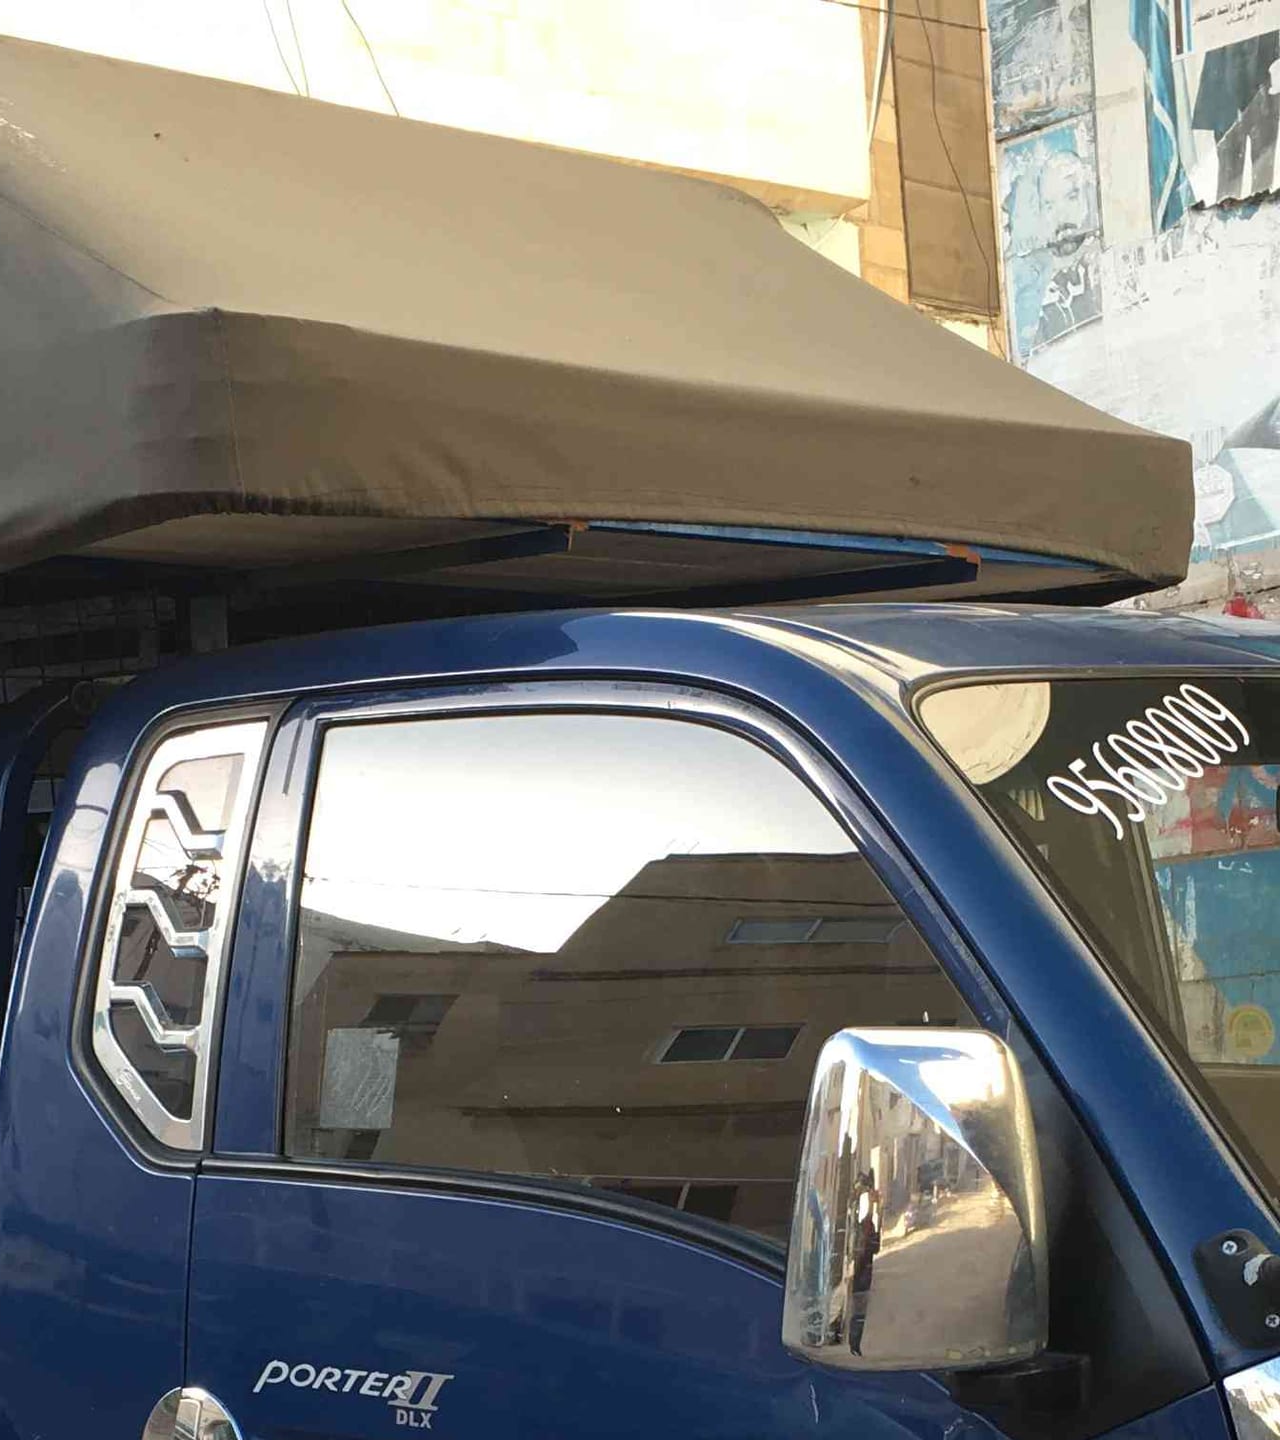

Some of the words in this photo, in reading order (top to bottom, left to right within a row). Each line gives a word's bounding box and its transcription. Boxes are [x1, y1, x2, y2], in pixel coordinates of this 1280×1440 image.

[1047, 683, 1250, 841] 95608009
[253, 1360, 413, 1399] PORTER
[395, 1410, 432, 1429] DLX
